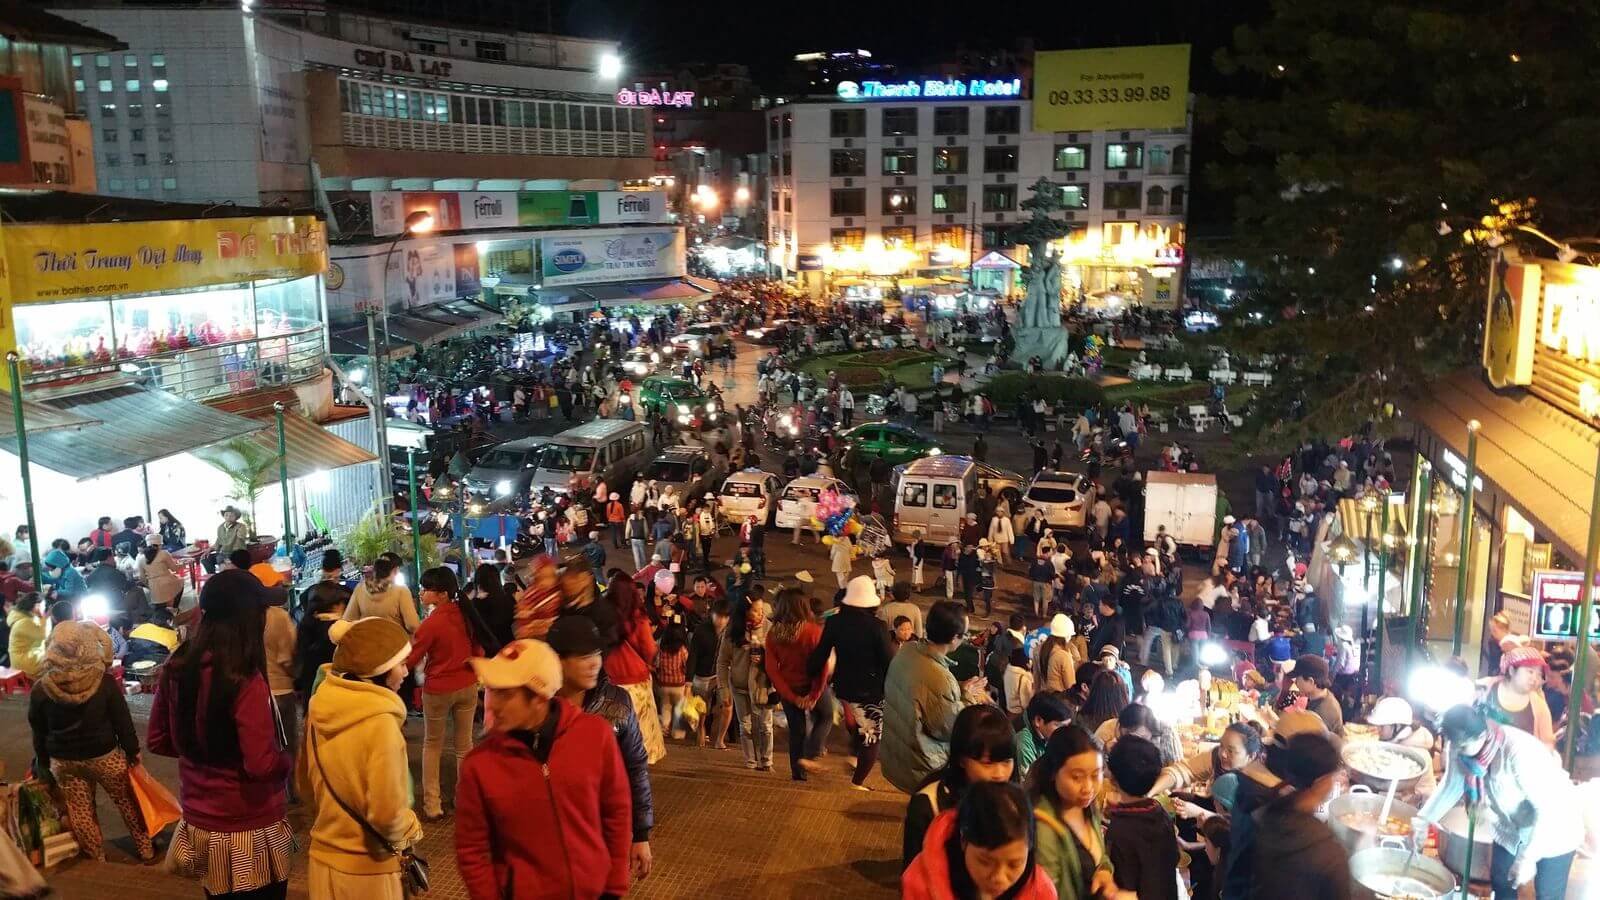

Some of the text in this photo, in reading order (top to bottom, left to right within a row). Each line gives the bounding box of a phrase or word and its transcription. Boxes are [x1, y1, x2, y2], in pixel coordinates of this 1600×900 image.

[1096, 71, 1145, 81] Advertising
[862, 80, 920, 97] Thanh
[970, 78, 1021, 96] Hotel
[1048, 85, 1171, 106] 09.33.33.99.88
[663, 91, 695, 107] LẠT
[474, 198, 503, 219] Ferroli
[617, 197, 650, 215] Ferroli
[34, 248, 78, 273] Thời
[82, 247, 134, 273] Trung
[137, 244, 167, 269] Dệt
[173, 243, 203, 265] May
[36, 282, 129, 298] www.bathien.com.vn
